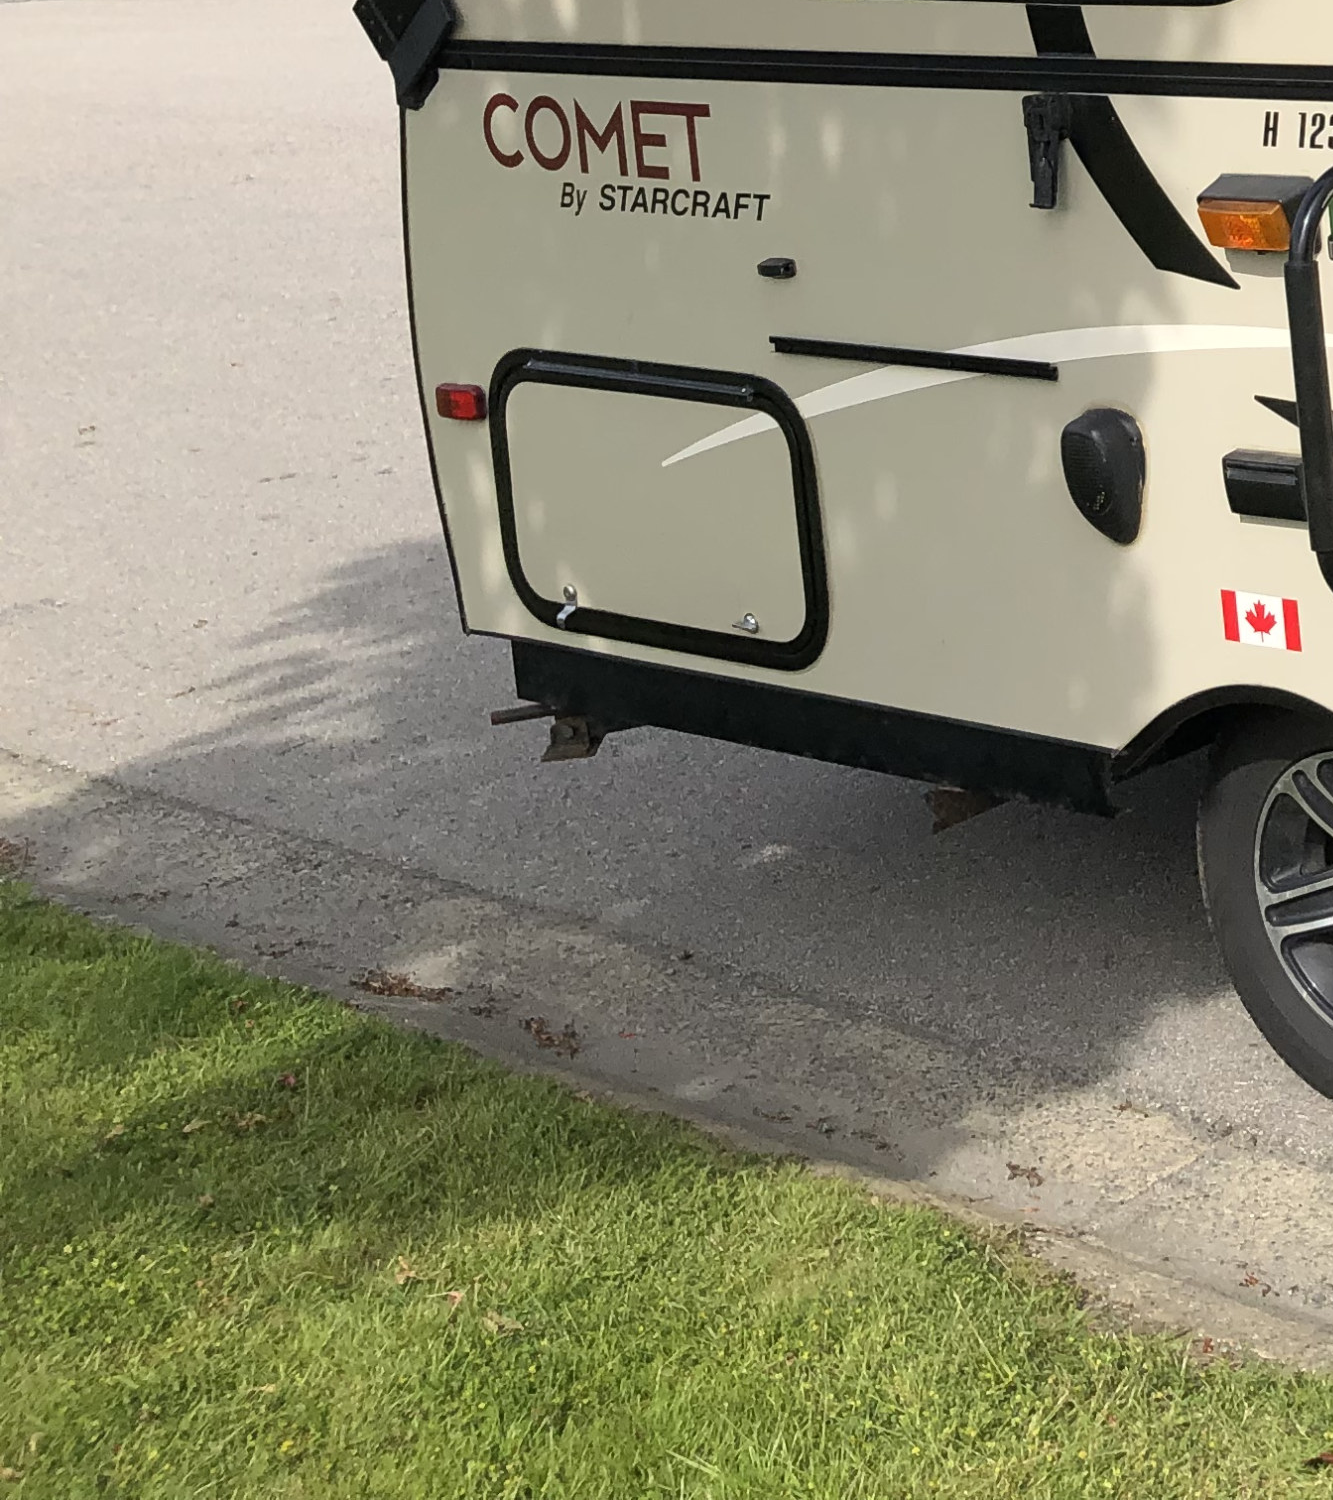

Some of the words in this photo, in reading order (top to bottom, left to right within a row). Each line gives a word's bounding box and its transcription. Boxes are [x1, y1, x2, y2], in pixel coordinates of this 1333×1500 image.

[483, 92, 711, 182] COMET
[1262, 111, 1279, 147] H
[560, 182, 588, 216] By
[599, 183, 771, 221] STARCRAFT
